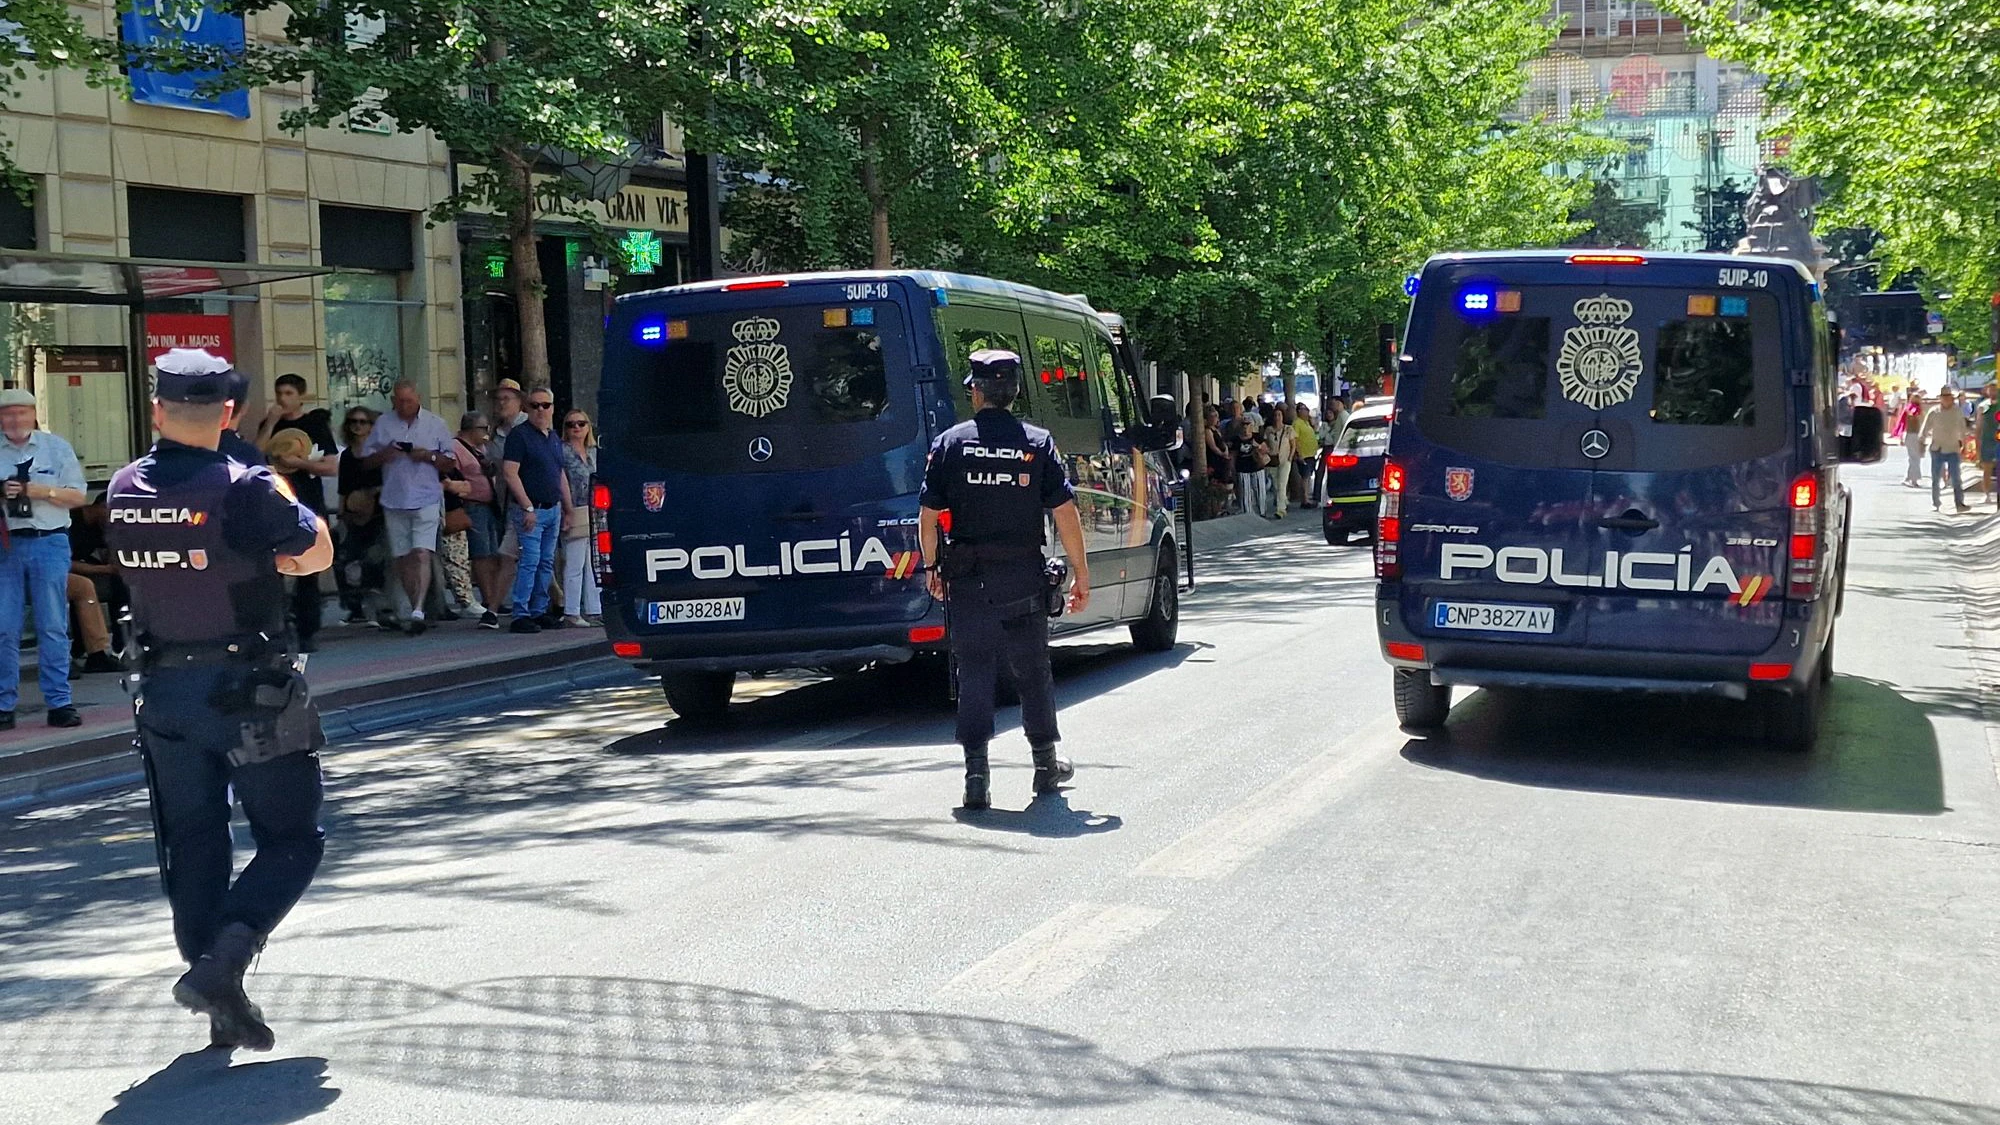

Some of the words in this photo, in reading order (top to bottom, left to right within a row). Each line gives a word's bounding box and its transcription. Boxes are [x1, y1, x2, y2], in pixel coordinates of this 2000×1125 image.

[605, 192, 646, 222] GRAN
[656, 196, 679, 225] VIA
[1718, 267, 1768, 288] 5UIP-10
[846, 282, 888, 300] 5UIP-18
[962, 446, 1025, 461] POLICIA
[966, 472, 1017, 486] U.I.P.
[110, 507, 193, 524] POLICIA
[1410, 523, 1479, 534] SPRINTER
[117, 549, 188, 569] U.I.P.
[645, 529, 896, 583] POLICÍA
[1440, 542, 1743, 594] POLICÍA
